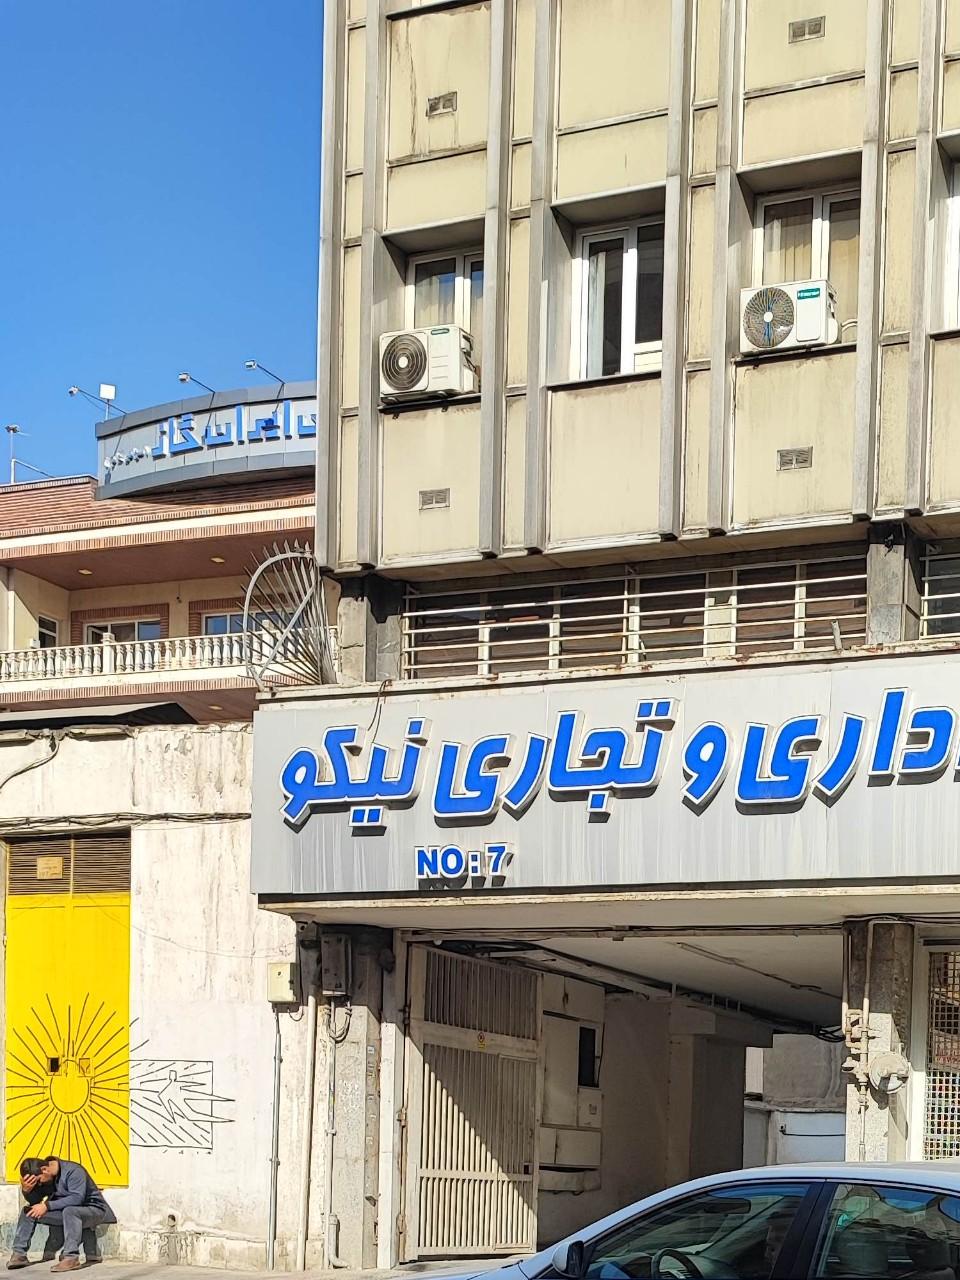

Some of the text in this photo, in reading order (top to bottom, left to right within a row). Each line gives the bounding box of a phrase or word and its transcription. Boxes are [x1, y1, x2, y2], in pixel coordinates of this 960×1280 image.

[280, 717, 430, 828] نیکو
[431, 698, 675, 818] تجاری
[682, 721, 729, 804] و
